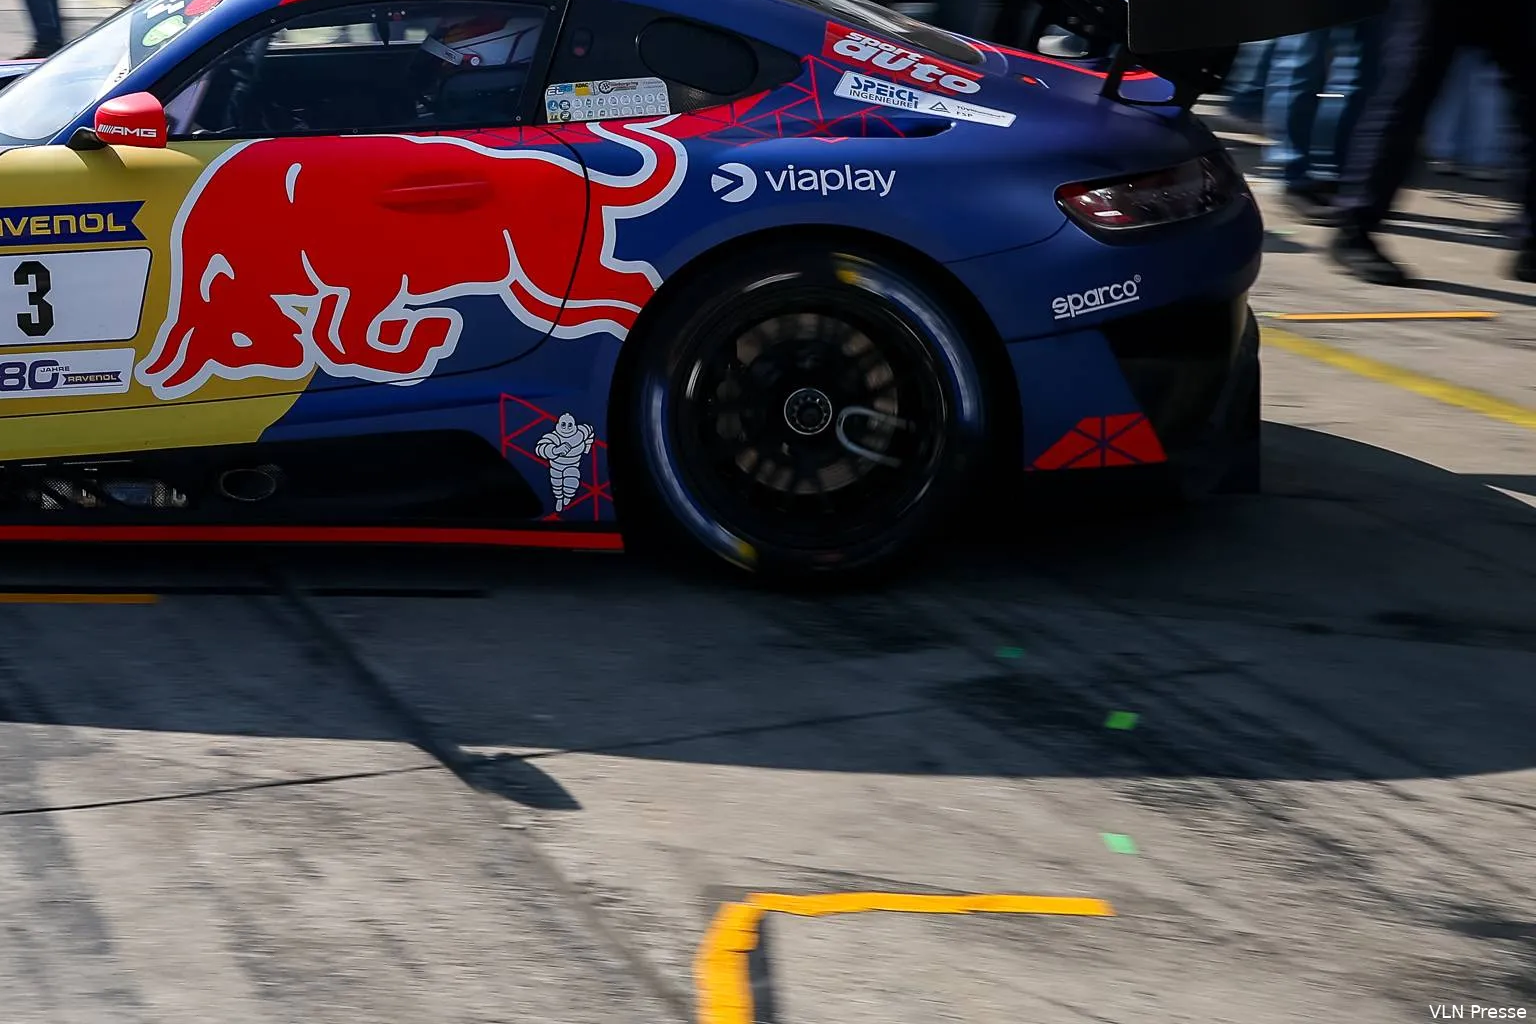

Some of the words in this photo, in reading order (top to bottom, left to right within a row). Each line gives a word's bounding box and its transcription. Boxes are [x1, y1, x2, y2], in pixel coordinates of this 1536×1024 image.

[845, 32, 924, 62] sport
[832, 39, 981, 94] auto
[764, 164, 897, 197] viaplay
[13, 260, 55, 337] 3
[1051, 279, 1138, 320] sparco
[40, 365, 70, 373] JAHRE
[67, 373, 118, 385] RAVENOL
